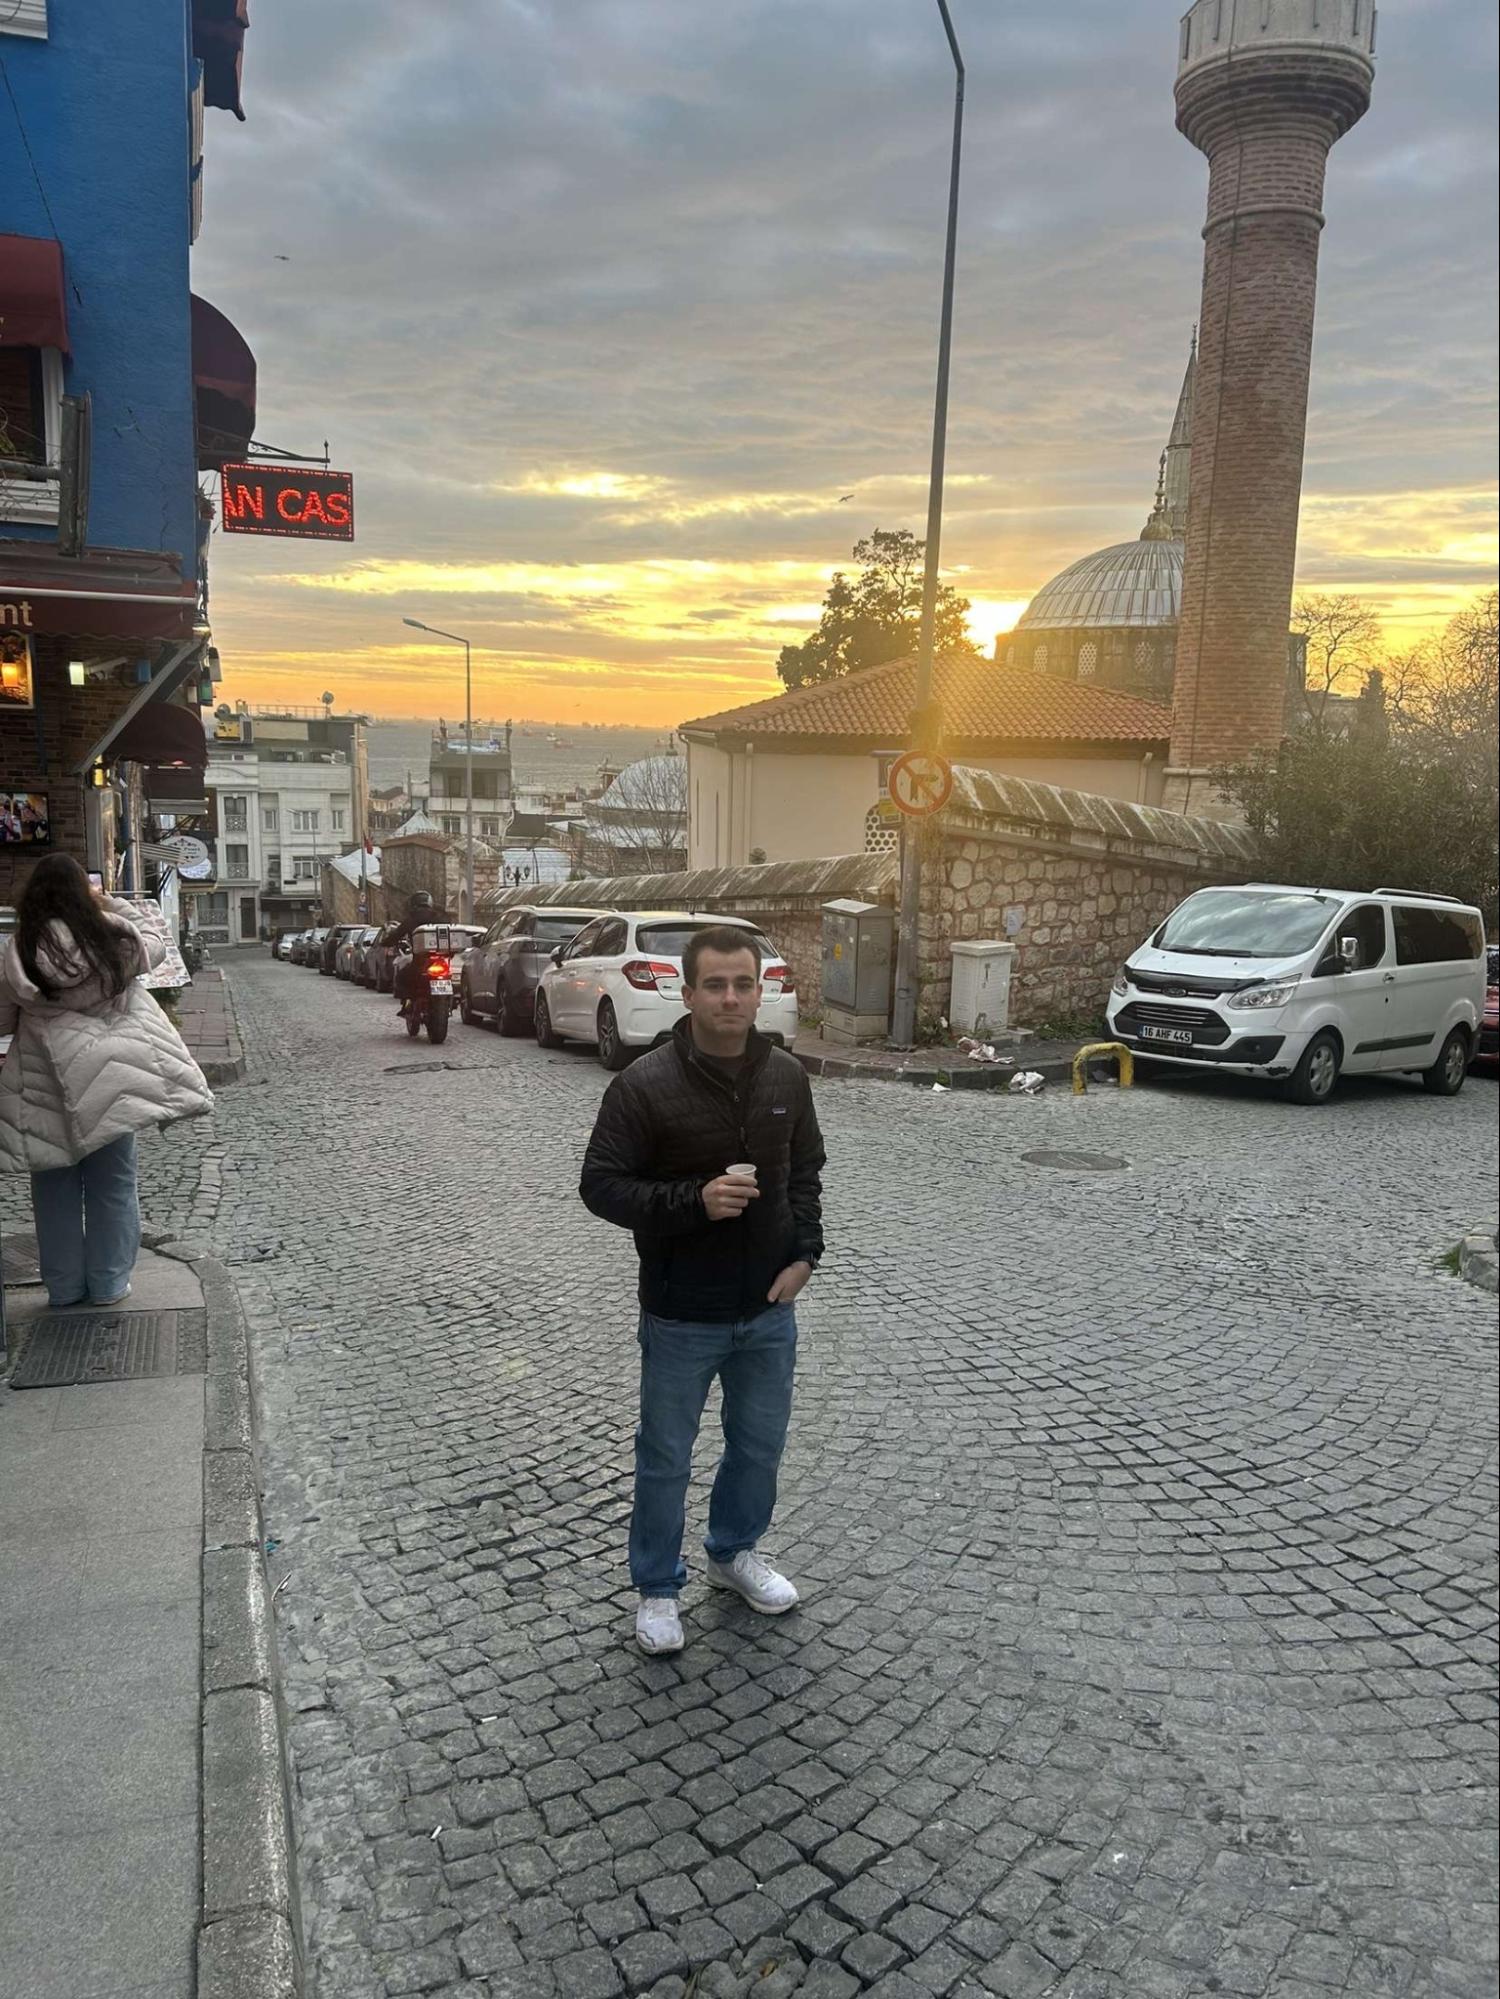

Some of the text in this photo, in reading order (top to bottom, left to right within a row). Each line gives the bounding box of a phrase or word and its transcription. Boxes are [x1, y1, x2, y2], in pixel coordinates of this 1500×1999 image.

[277, 488, 349, 526] CAS
[1144, 1026, 1190, 1042] 16 AHF 445
